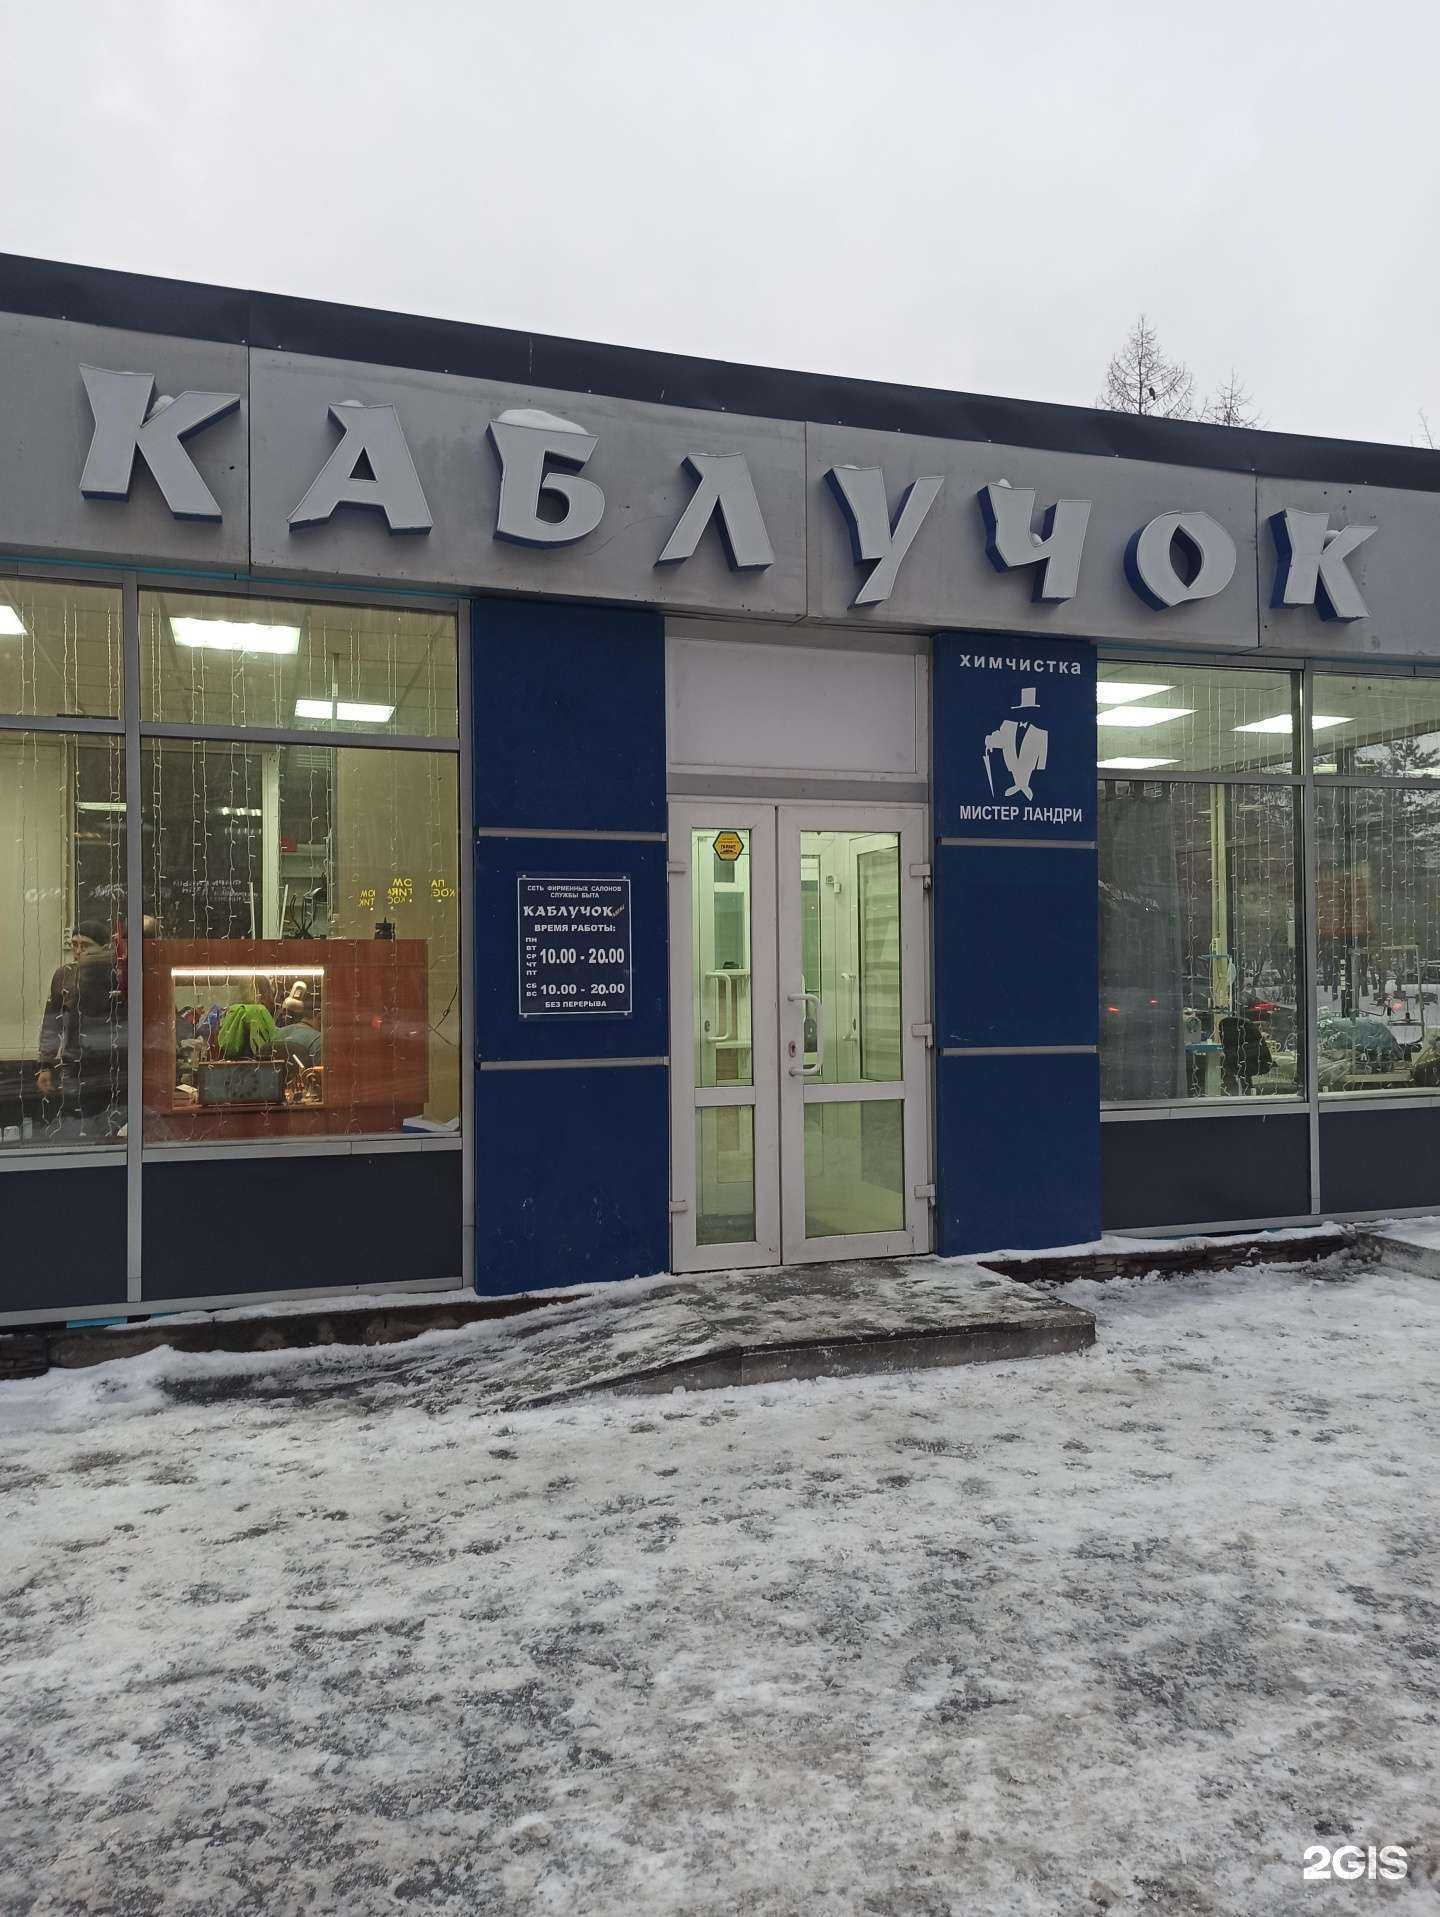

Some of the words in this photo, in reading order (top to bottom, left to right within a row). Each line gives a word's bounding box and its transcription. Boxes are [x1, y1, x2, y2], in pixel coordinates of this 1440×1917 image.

[79, 364, 1378, 622] КАБЛУЧОК
[959, 805, 1019, 821] МИСТЕР
[1022, 806, 1082, 824] ЛАНДРИ
[523, 905, 613, 919] КАБЛУЧОК
[534, 924, 568, 932] ВРЕМЯ
[571, 924, 616, 932] РАБОТЫ:
[540, 948, 577, 964] 10.00
[588, 948, 625, 964] 20.00
[540, 984, 577, 995] 10.00
[590, 983, 625, 994] 20.00
[562, 1000, 607, 1008] ПЕРЕРЫВА
